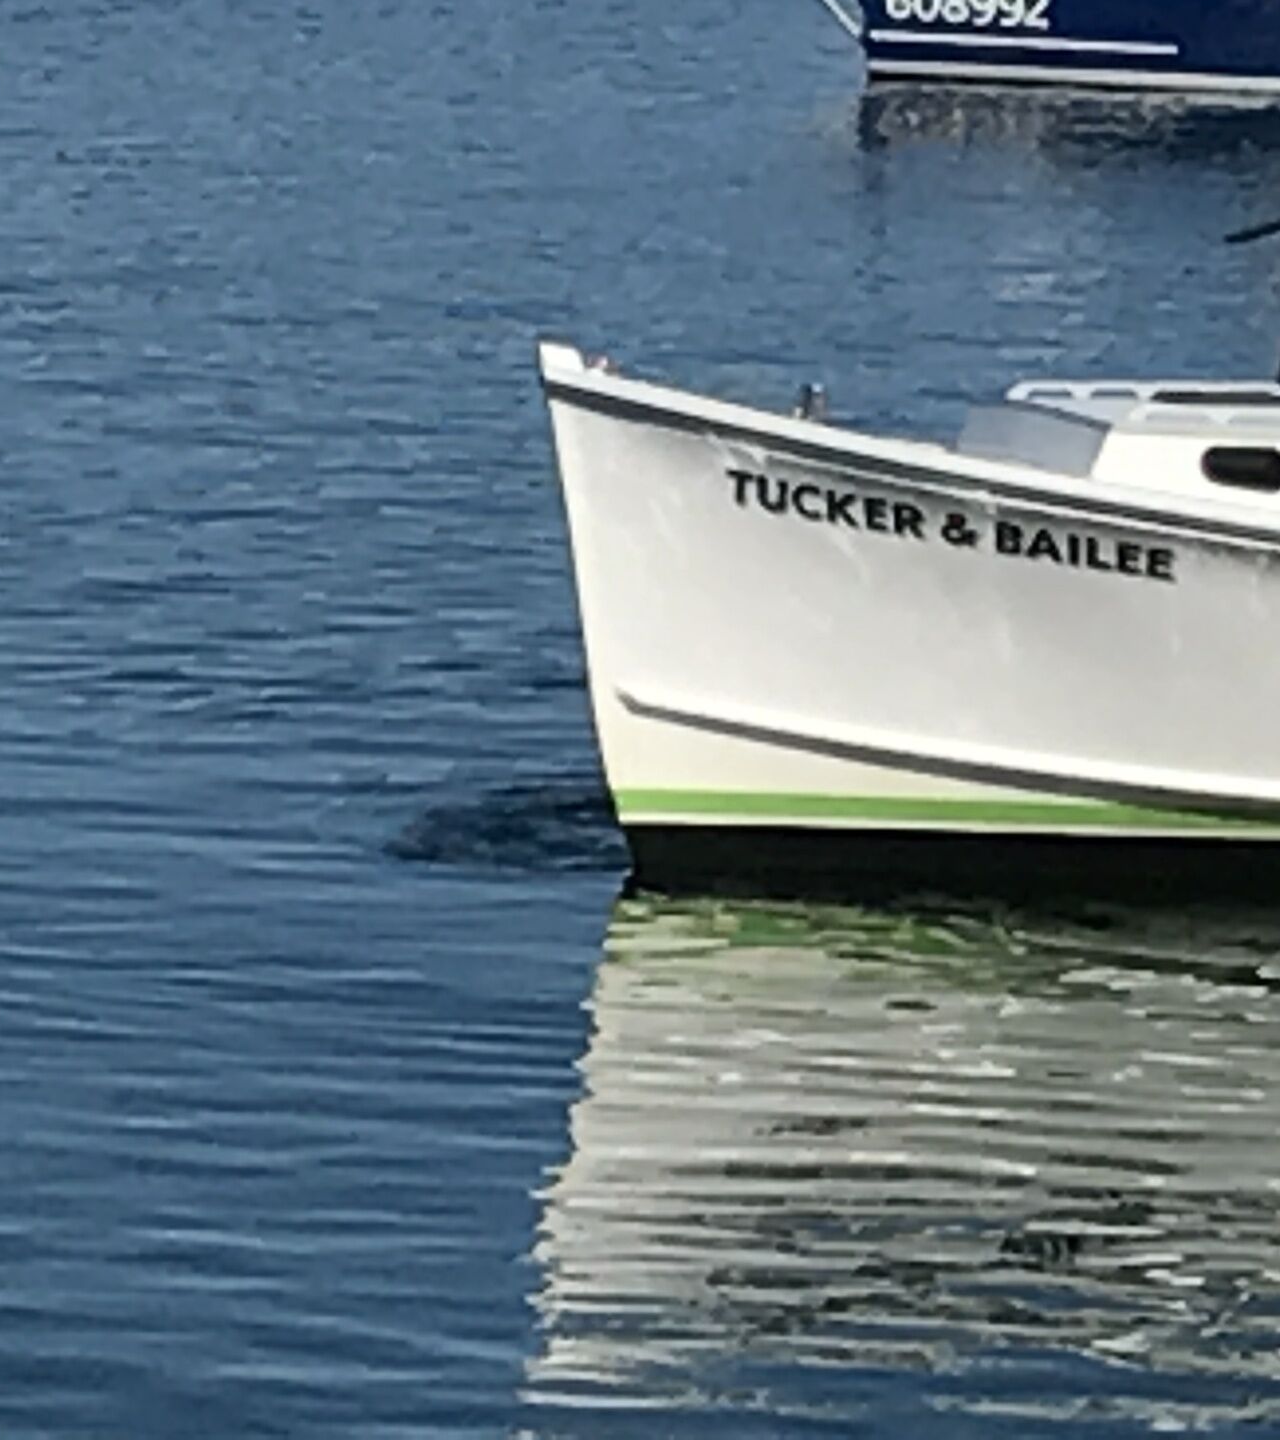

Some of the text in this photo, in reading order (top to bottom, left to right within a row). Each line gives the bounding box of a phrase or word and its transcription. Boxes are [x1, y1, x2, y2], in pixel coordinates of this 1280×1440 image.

[725, 469, 1177, 582] TUCKER & BAILEE
